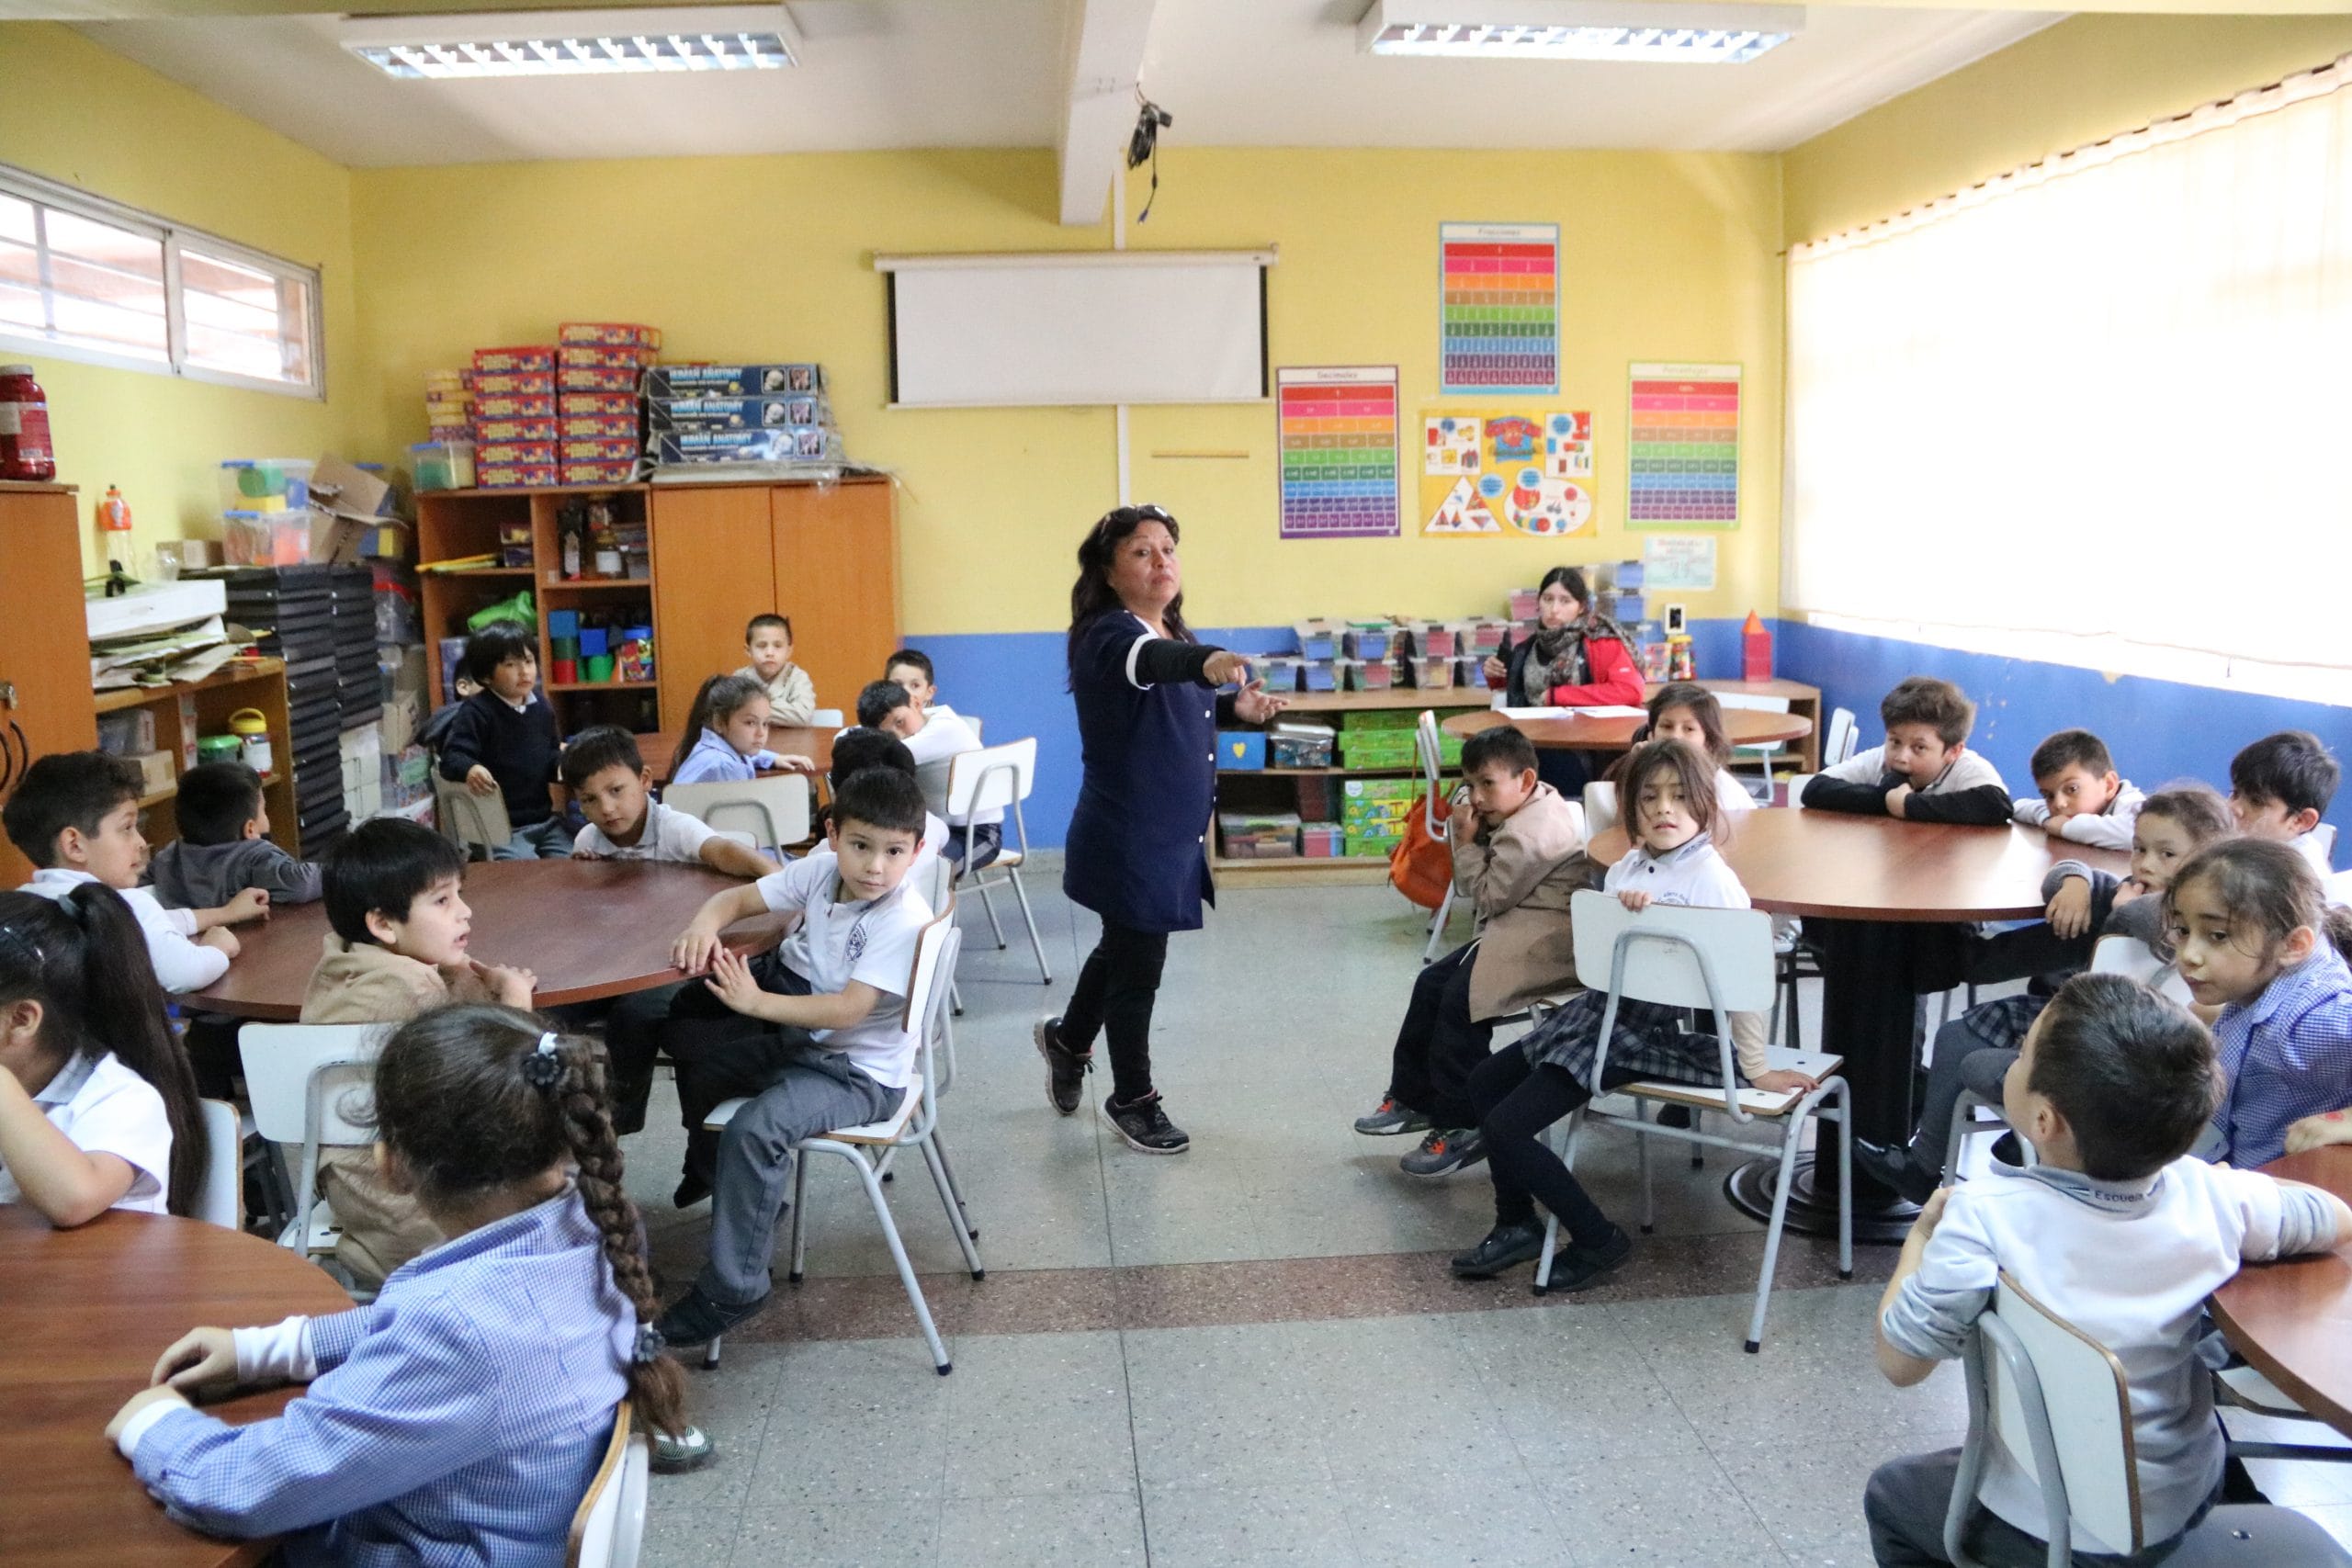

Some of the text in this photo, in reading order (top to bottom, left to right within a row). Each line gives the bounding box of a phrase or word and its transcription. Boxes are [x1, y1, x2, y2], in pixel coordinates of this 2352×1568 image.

[669, 367, 743, 380] HUMAN ANATOMY
[670, 400, 744, 412] HUMAN ANATOMY
[679, 432, 752, 446] HUMAN ANATOMY
[2095, 1190, 2144, 1203] Escuela
